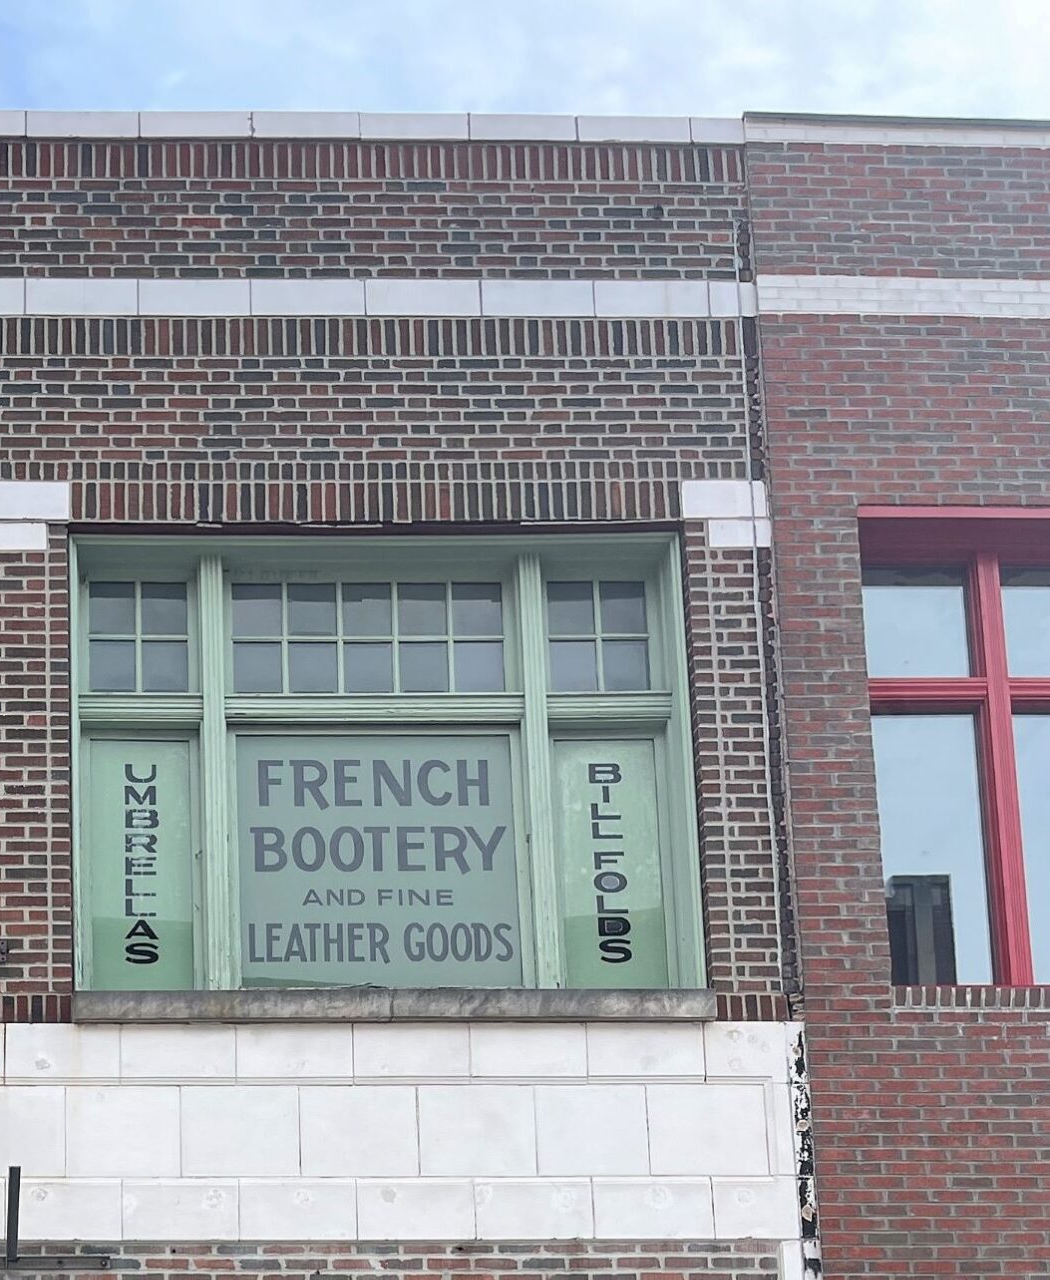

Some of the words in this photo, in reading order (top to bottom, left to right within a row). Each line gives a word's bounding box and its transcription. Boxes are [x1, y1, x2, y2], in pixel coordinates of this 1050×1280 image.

[257, 759, 490, 811] FRENCH
[588, 763, 624, 840] BILL
[124, 763, 160, 965] UMBRELLAS
[249, 825, 507, 875] BOOTERY
[302, 888, 366, 907] AND
[377, 888, 454, 907] FINE
[593, 851, 633, 964] FOLDS
[248, 922, 391, 965] LEATHER
[403, 922, 514, 963] GOODS
